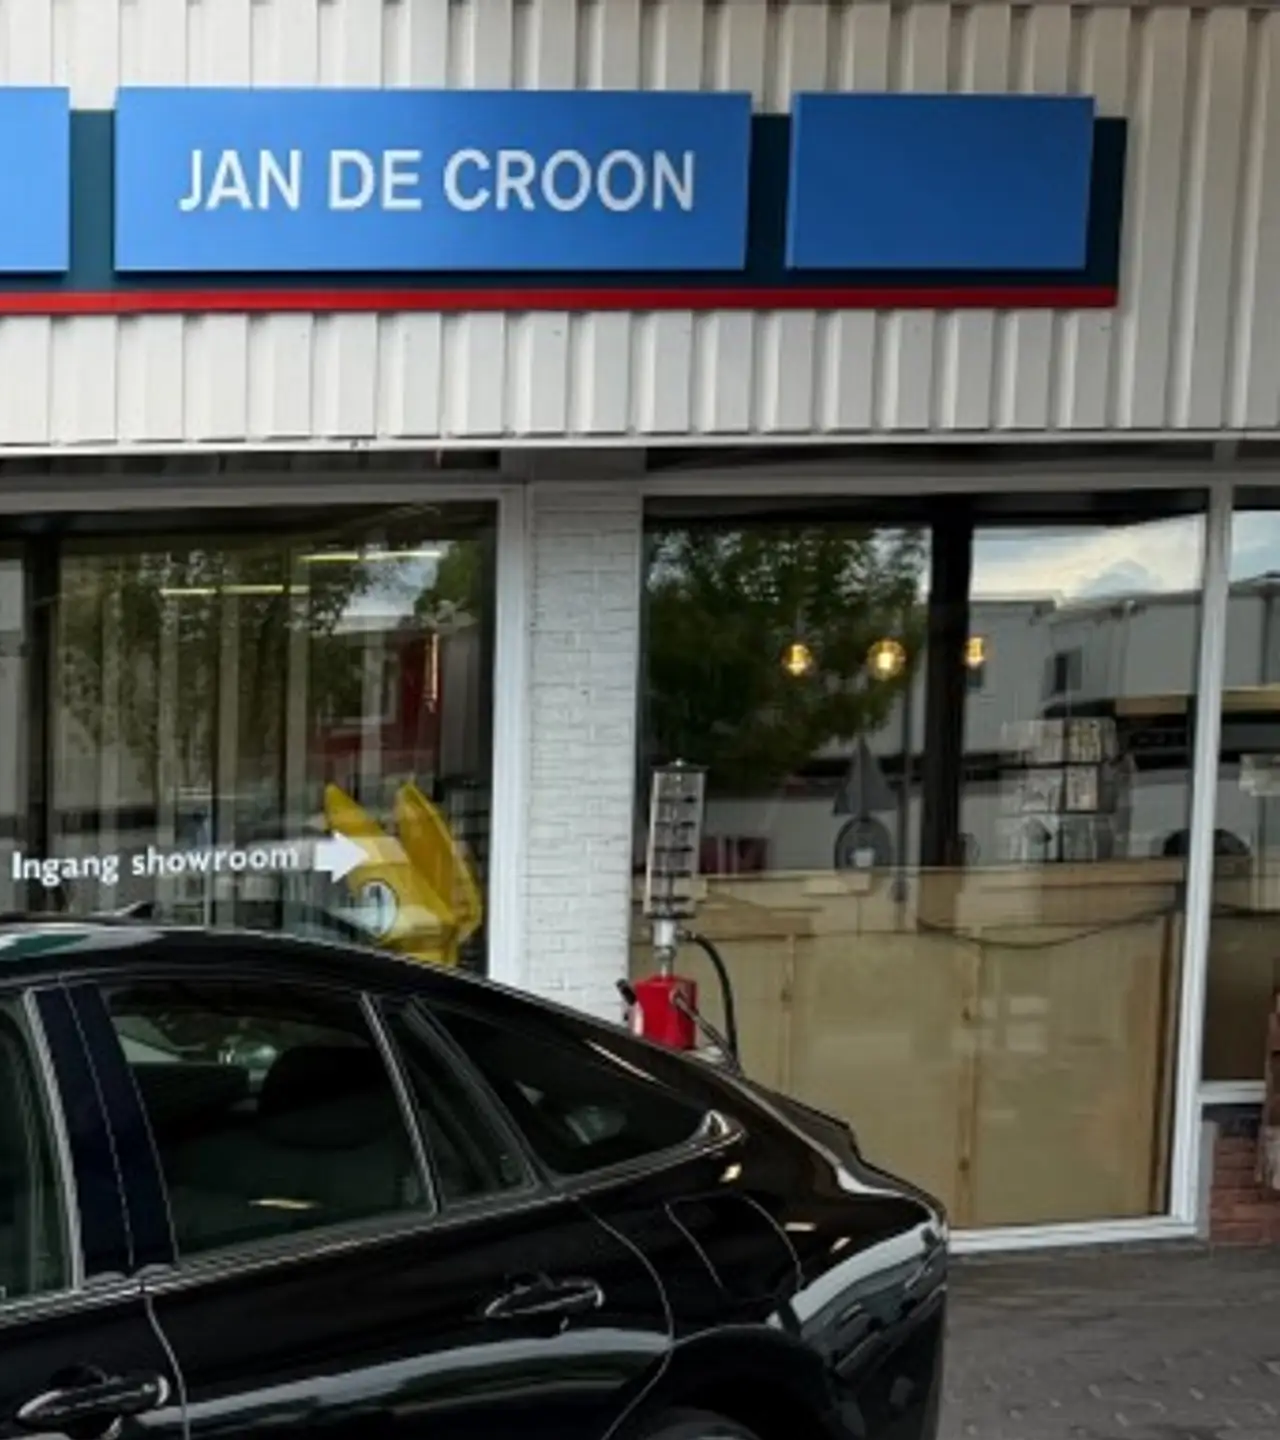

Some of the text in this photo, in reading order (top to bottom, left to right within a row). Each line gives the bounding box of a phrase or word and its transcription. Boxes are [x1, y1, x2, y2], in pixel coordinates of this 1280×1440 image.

[178, 148, 697, 213] JAN DE CROON
[11, 844, 301, 888] Ingang showroom
